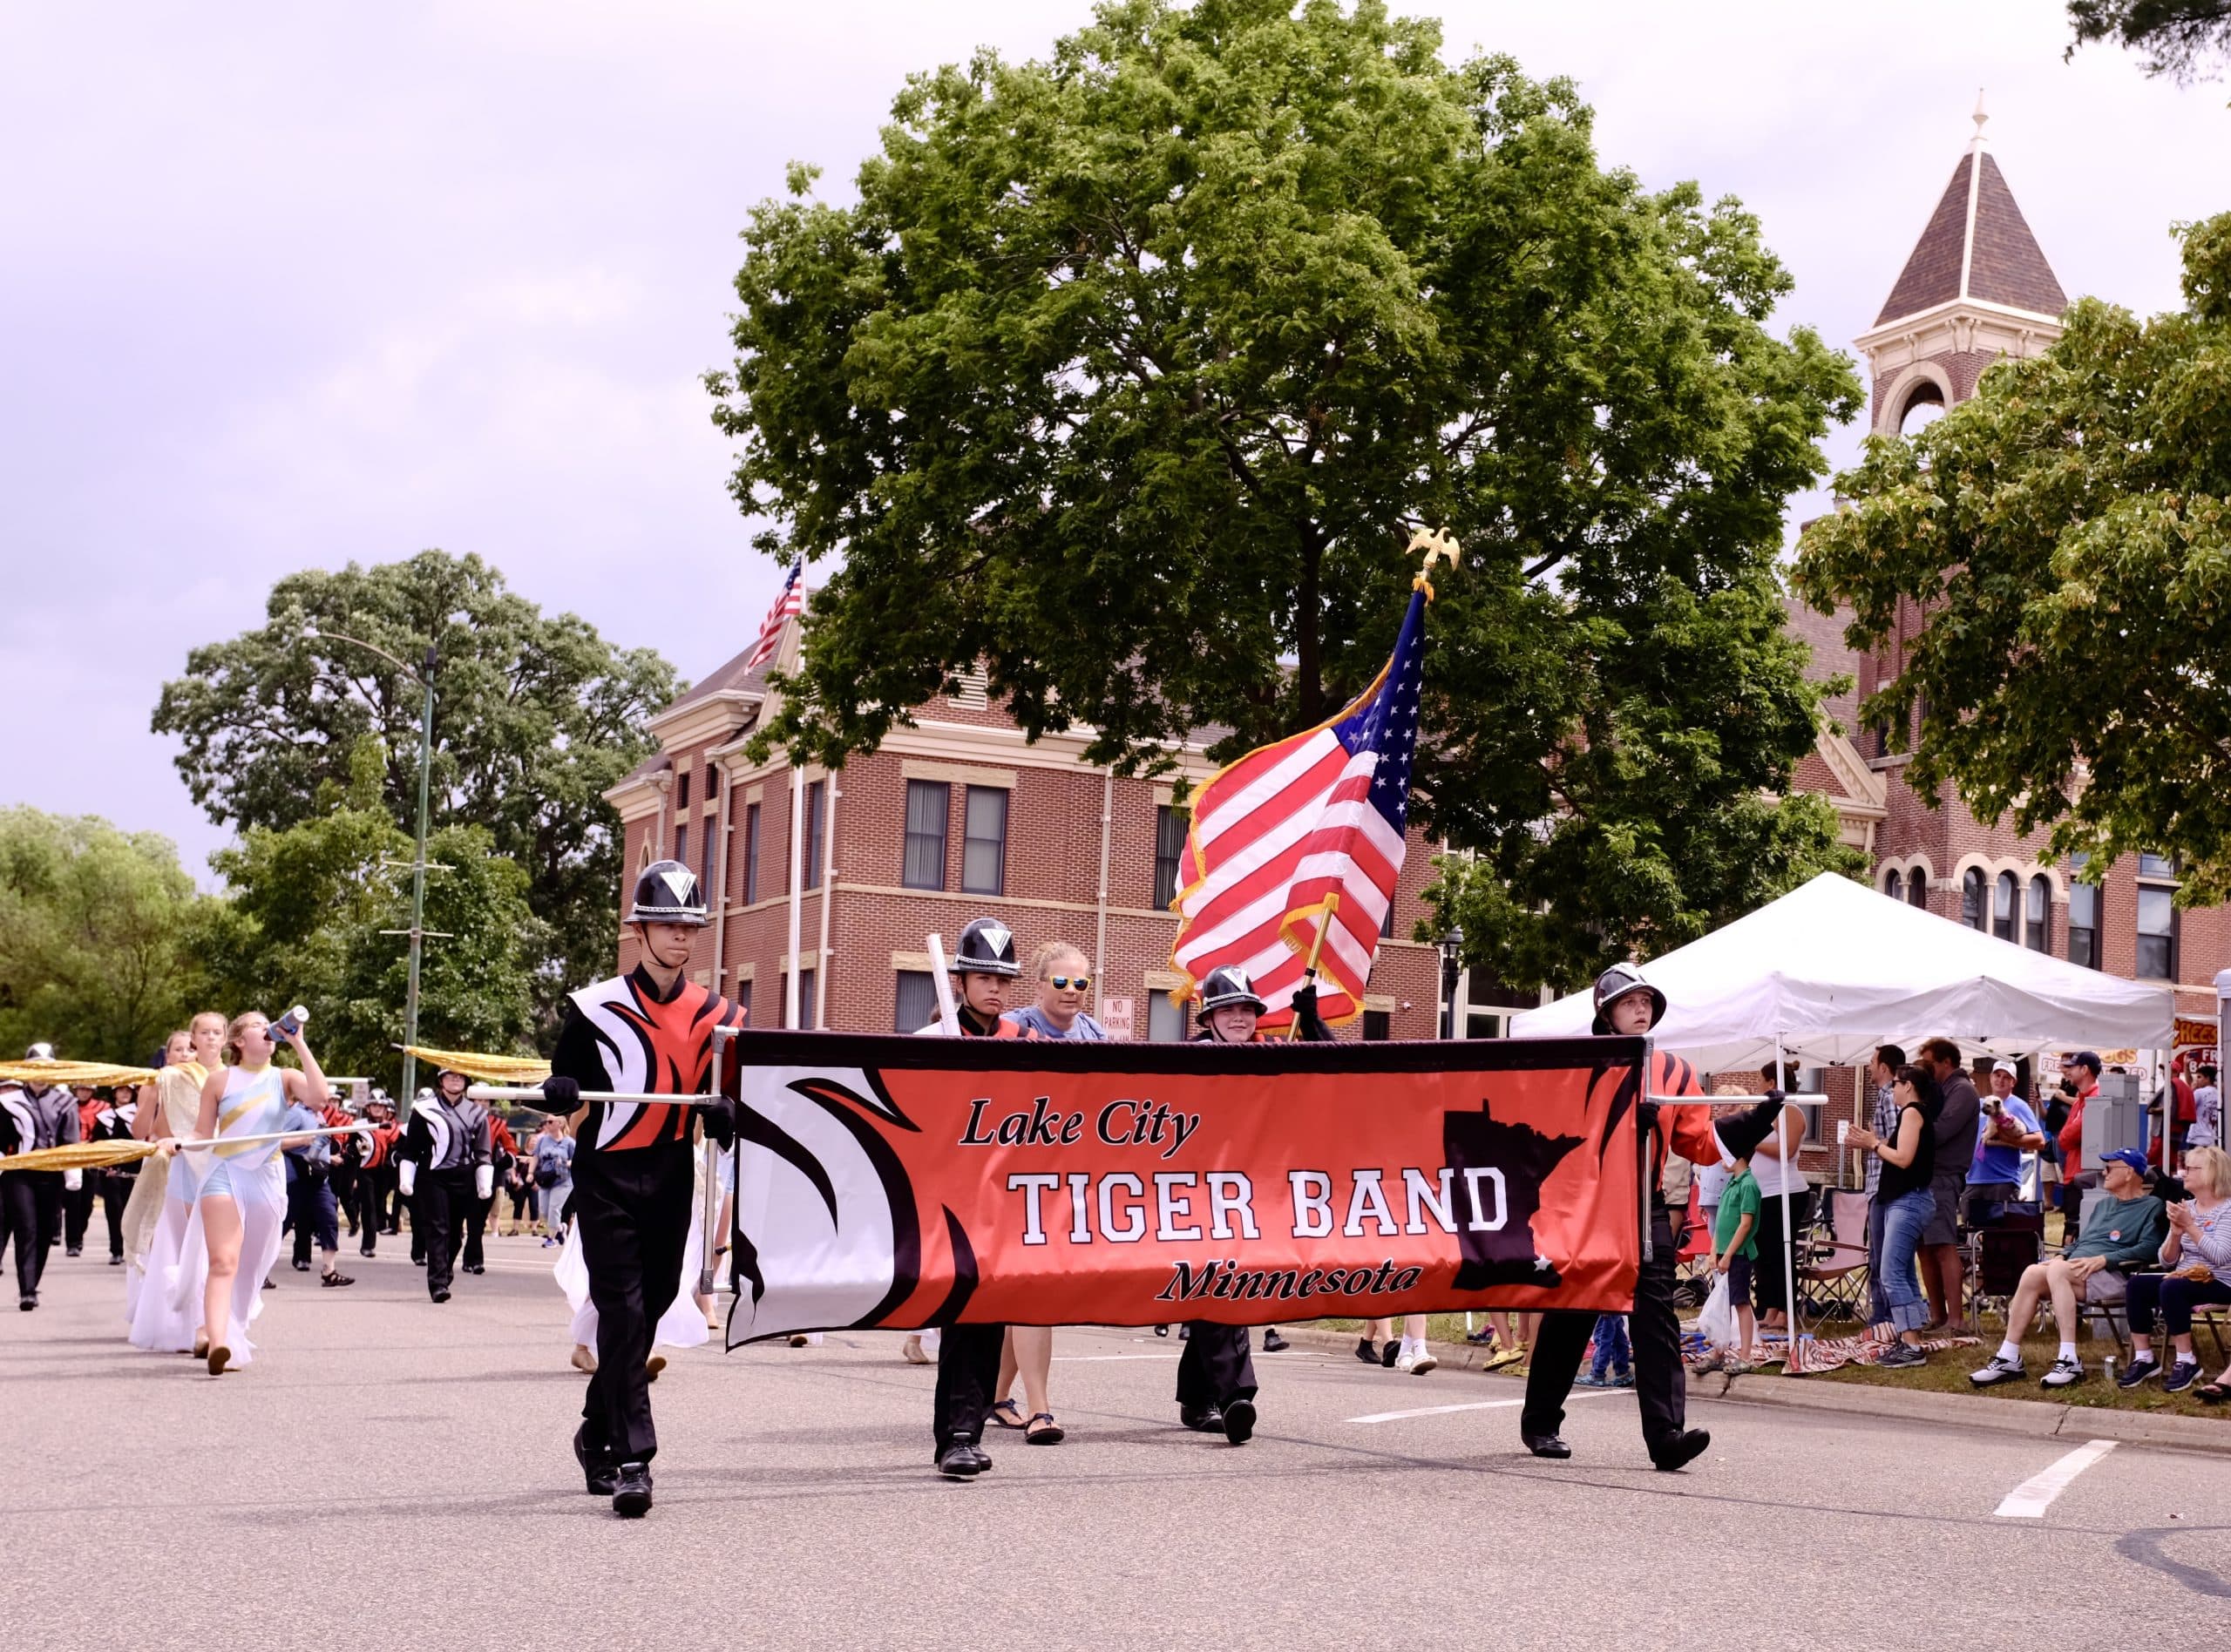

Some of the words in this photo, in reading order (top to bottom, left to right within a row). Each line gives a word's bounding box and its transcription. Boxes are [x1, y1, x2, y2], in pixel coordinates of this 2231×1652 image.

[1112, 1000, 1122, 1012] NO
[1104, 1017, 1130, 1030] PARKING
[2173, 1018, 2218, 1049] CHEES
[2042, 1057, 2062, 1073] FRE
[2101, 1049, 2137, 1064] OGS
[958, 1096, 1084, 1147] Lake
[1096, 1099, 1200, 1160] City
[1007, 1171, 1262, 1245] TIGER
[1286, 1166, 1509, 1239] BAND
[1154, 1257, 1424, 1302] Minnesota
